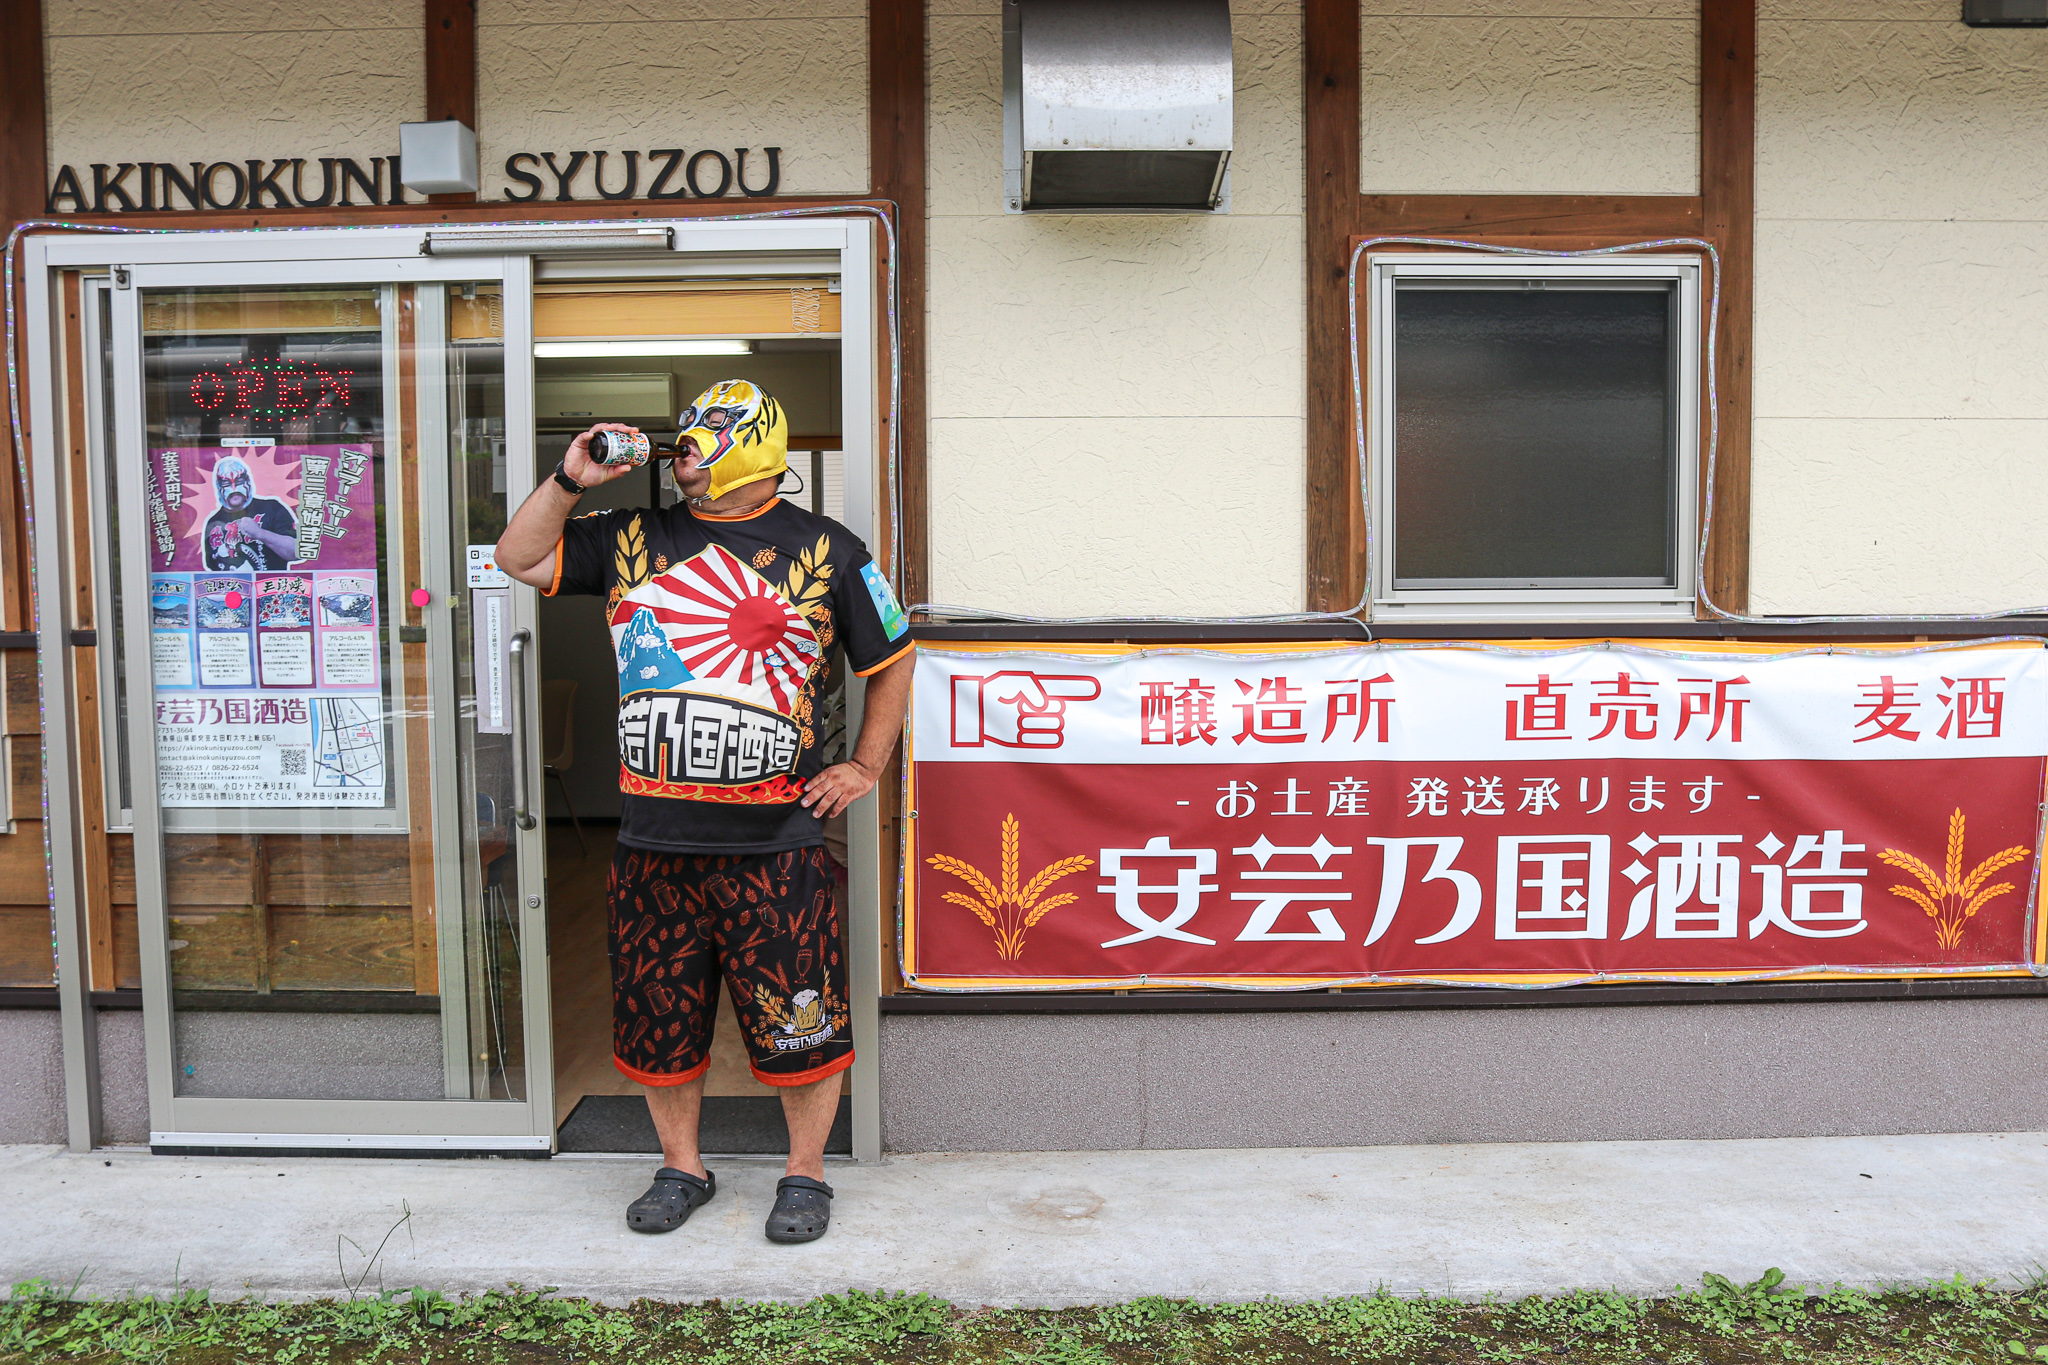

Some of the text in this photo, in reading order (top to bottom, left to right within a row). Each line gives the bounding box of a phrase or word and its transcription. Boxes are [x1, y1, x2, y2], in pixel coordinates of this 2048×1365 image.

[45, 147, 782, 213] AKINOKUNI SYUZOU
[191, 371, 354, 409] OPEN
[161, 451, 182, 511] 安芸太田町で
[299, 457, 330, 560] 第二章始まる
[263, 576, 306, 594] 三段峡
[1140, 672, 2006, 747] 醸造所 直売所 麦酒
[1216, 775, 1371, 818] お土産
[1406, 775, 1724, 817] 発送承ります
[1097, 829, 1868, 948] 安芸乃国酒造
